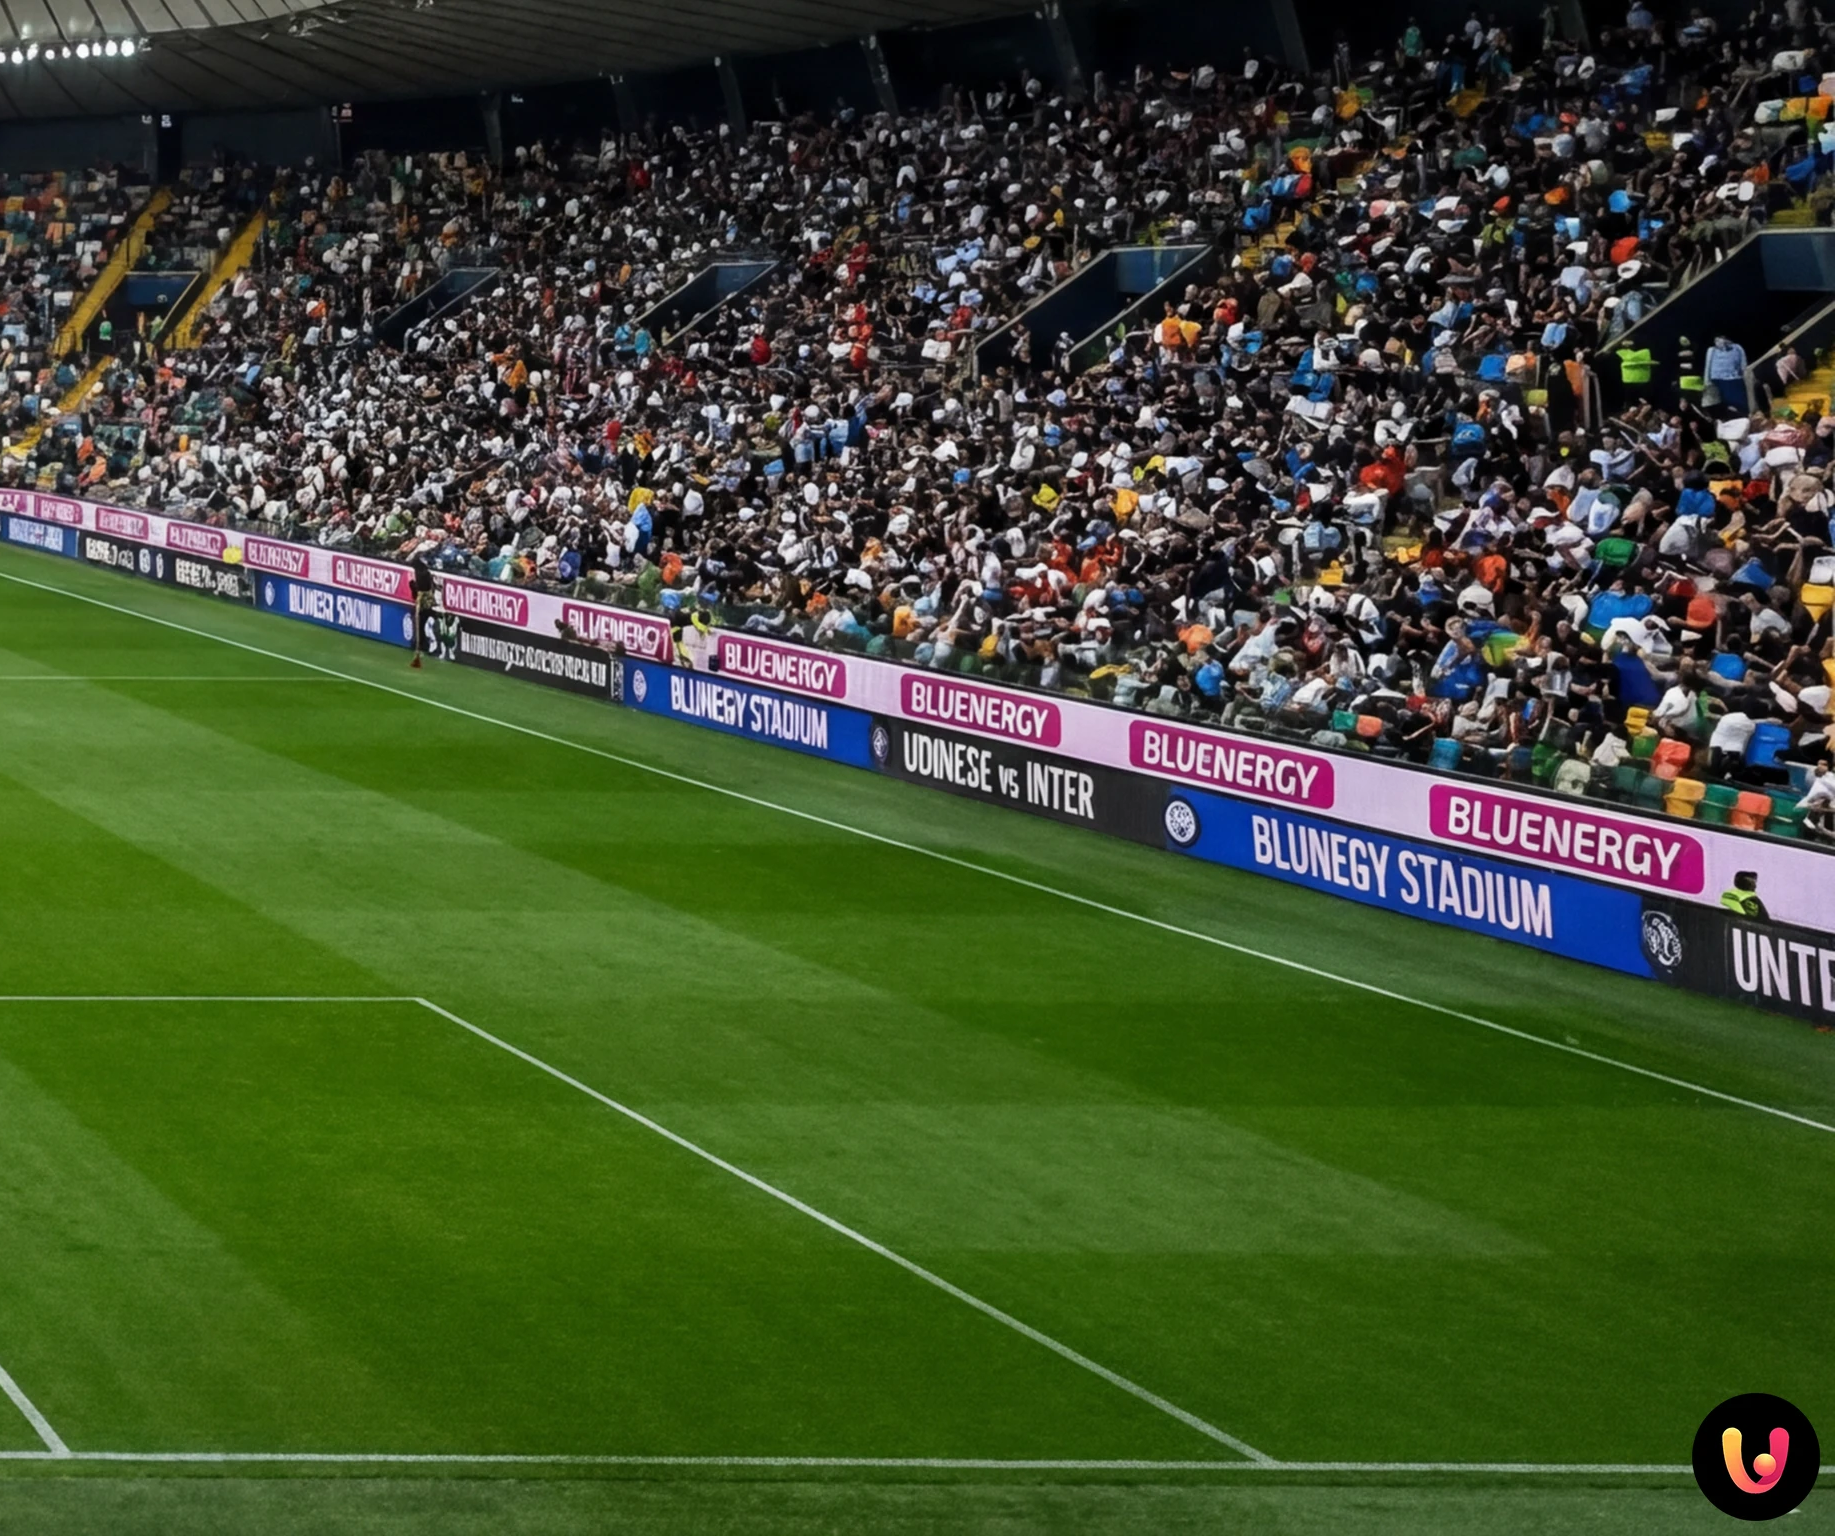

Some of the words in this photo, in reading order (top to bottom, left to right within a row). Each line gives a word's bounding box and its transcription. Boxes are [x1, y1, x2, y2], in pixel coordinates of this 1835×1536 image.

[750, 694, 828, 750] STADIUM
[911, 681, 1048, 739] BLUENERGY
[903, 731, 993, 794] UDINESE
[1027, 761, 1095, 819] INTER
[1142, 729, 1319, 800] BLUENERGY
[1252, 815, 1390, 898] BLUNEGY
[1401, 850, 1553, 940] STADIUM
[1448, 796, 1682, 881] BLUENERGY
